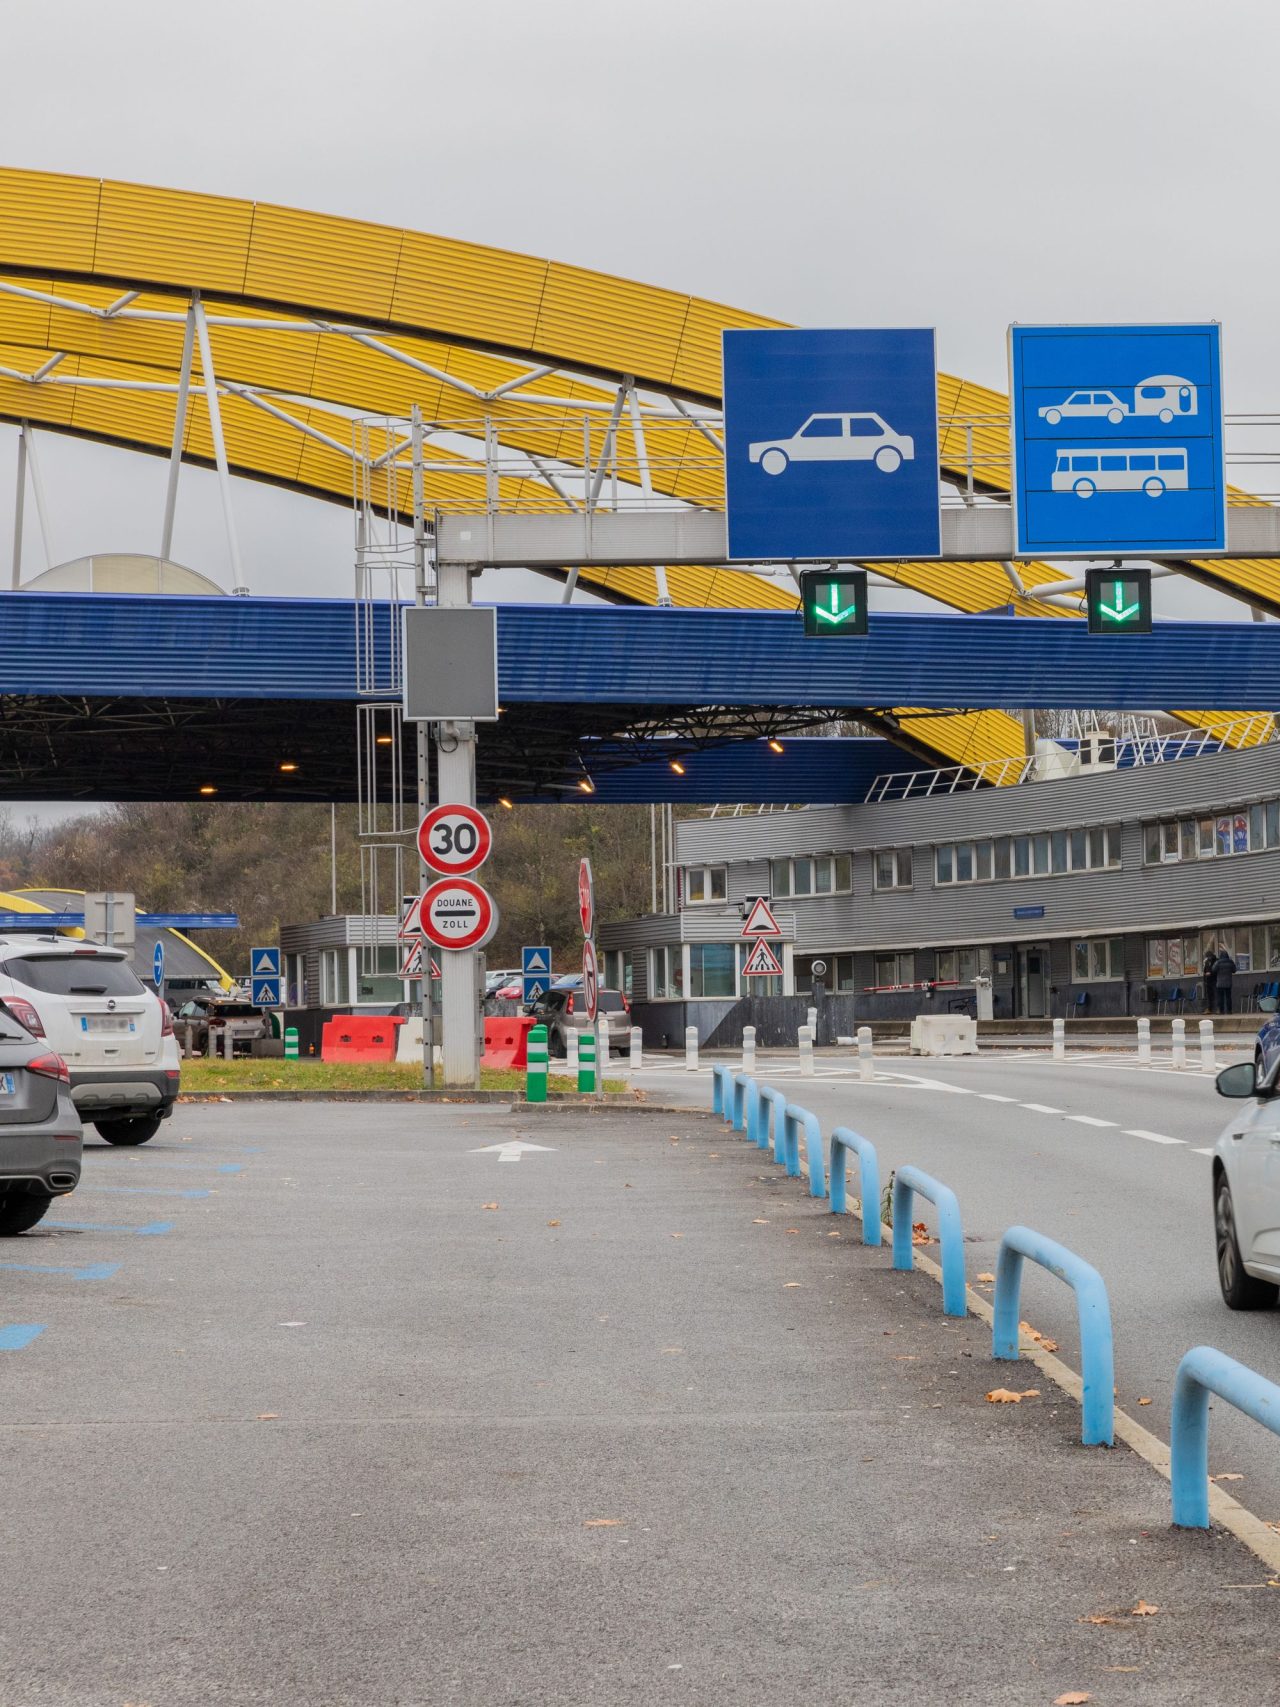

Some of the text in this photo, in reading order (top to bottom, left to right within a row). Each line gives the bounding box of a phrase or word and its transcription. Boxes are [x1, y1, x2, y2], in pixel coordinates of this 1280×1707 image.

[432, 823, 477, 855] 30
[437, 898, 474, 908] DOUANE
[442, 920, 469, 929] ZOLL
